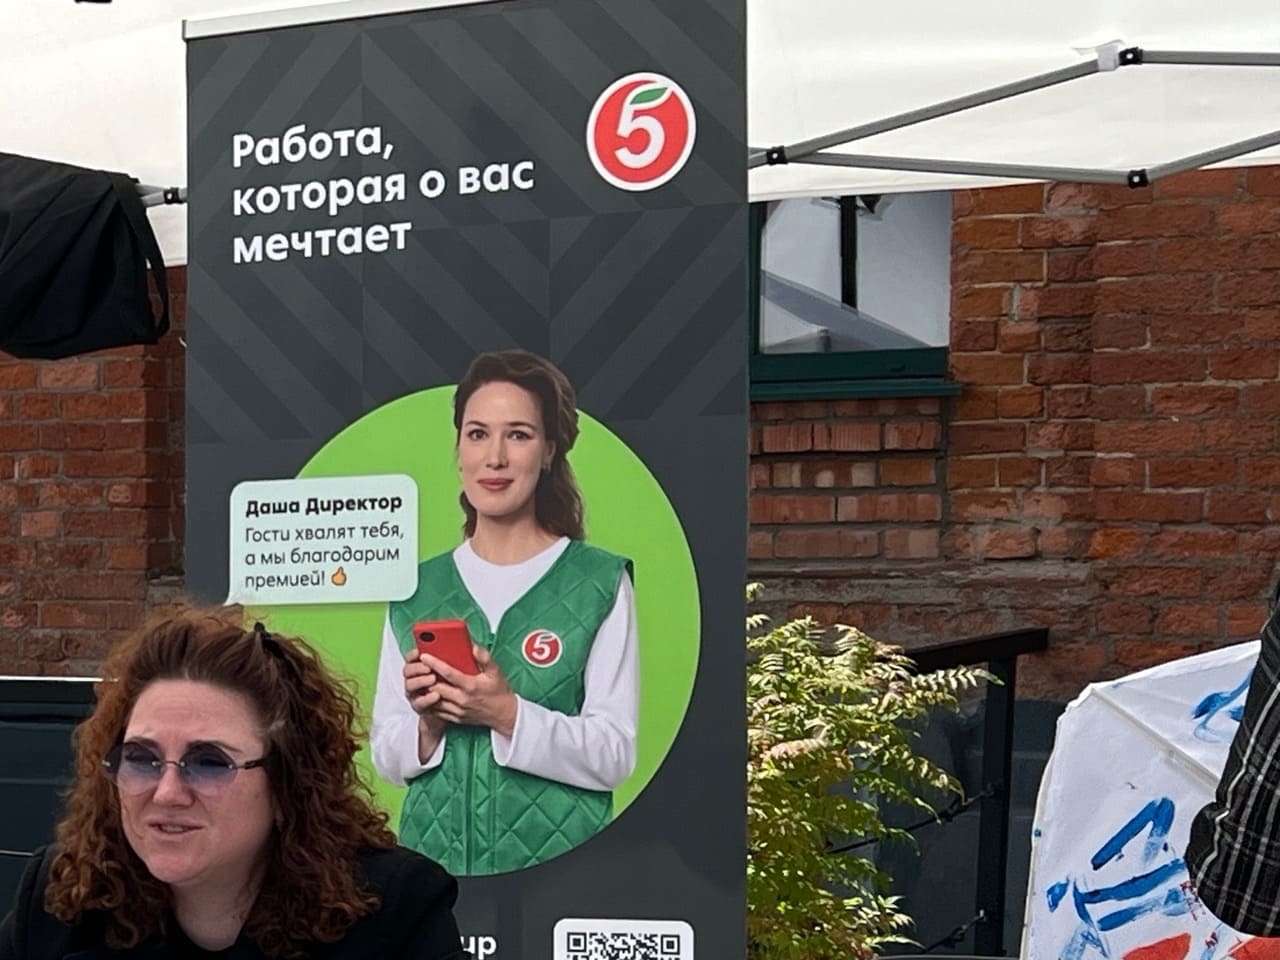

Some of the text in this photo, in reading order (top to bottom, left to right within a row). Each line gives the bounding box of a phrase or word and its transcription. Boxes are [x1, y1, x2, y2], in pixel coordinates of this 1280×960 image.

[615, 81, 674, 169] 5
[232, 124, 394, 168] Работа,
[232, 161, 536, 216] которая о вас
[232, 221, 412, 264] мечтает
[245, 496, 403, 518] Даша Директор
[245, 521, 404, 542] Гости хвалят тебя,
[245, 546, 400, 565] а мы благодарим
[245, 571, 325, 591] премией!
